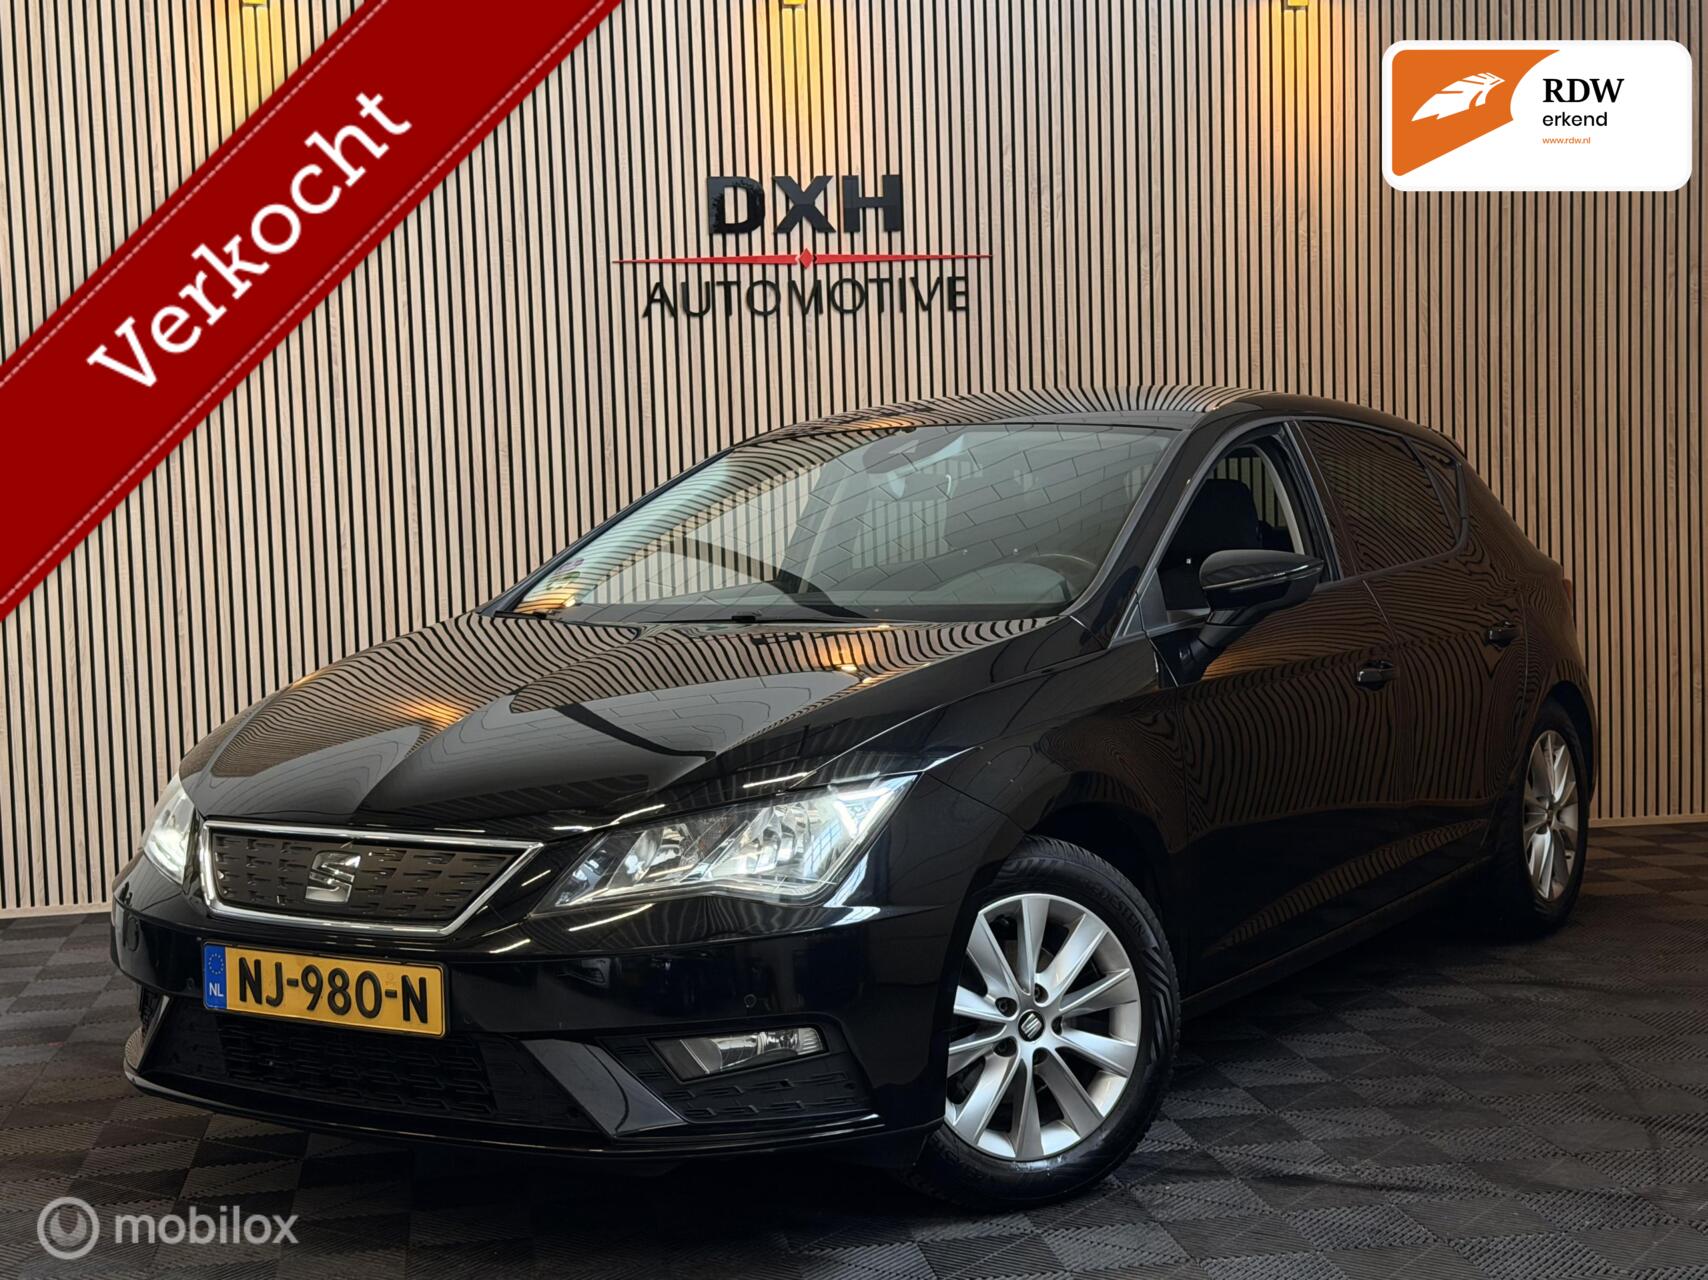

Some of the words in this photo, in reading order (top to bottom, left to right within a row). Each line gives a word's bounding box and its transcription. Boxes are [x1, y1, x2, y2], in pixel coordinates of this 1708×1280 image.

[707, 174, 901, 235] DXH
[643, 275, 969, 318] AUTOMOTIVE
[209, 982, 225, 997] NL
[238, 956, 428, 1024] NJ-980-N
